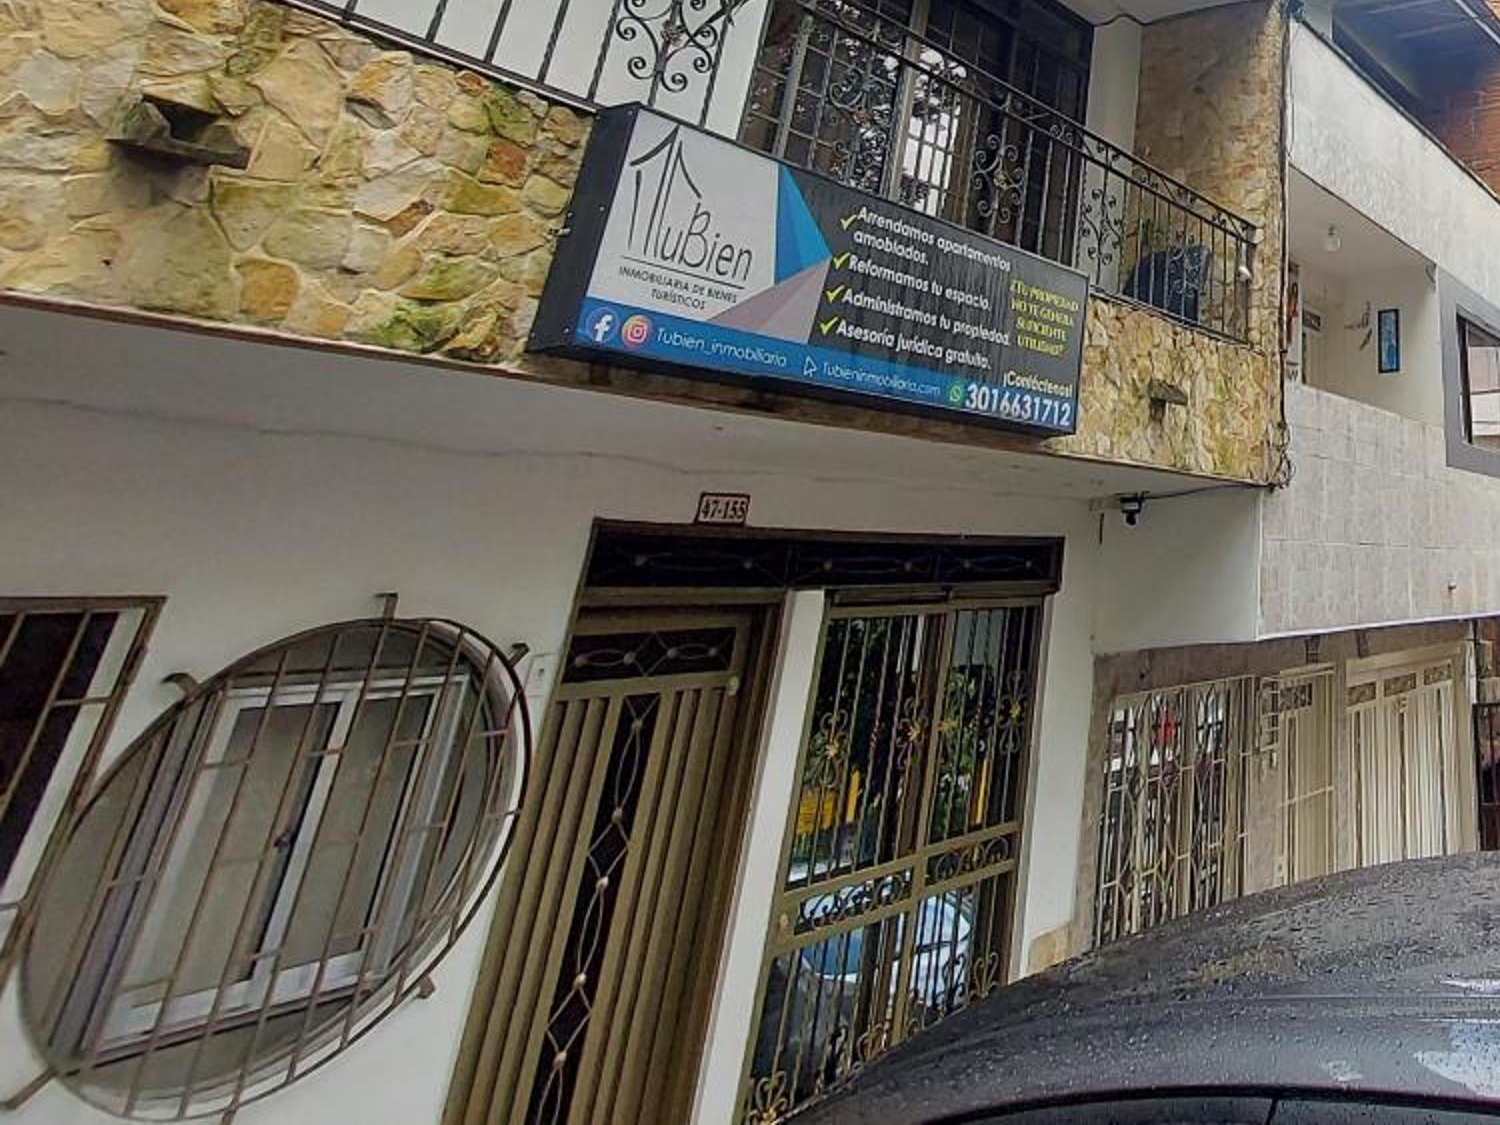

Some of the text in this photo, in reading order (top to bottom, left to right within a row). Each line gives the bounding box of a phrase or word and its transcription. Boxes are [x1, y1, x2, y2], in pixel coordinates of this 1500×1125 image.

[853, 229, 929, 265] amoblados.
[857, 206, 1011, 272] Arrendamos apartamentos
[619, 266, 738, 304] INMOBILIARIA DE BIENES
[849, 254, 929, 291] Reformamos
[931, 279, 943, 296] tu
[841, 288, 937, 326] Administramos
[939, 313, 951, 330] tu
[1011, 297, 1027, 312] NO
[836, 318, 895, 347] Asesoría
[965, 383, 1072, 426] 3016631712
[702, 498, 746, 520] 47-155
